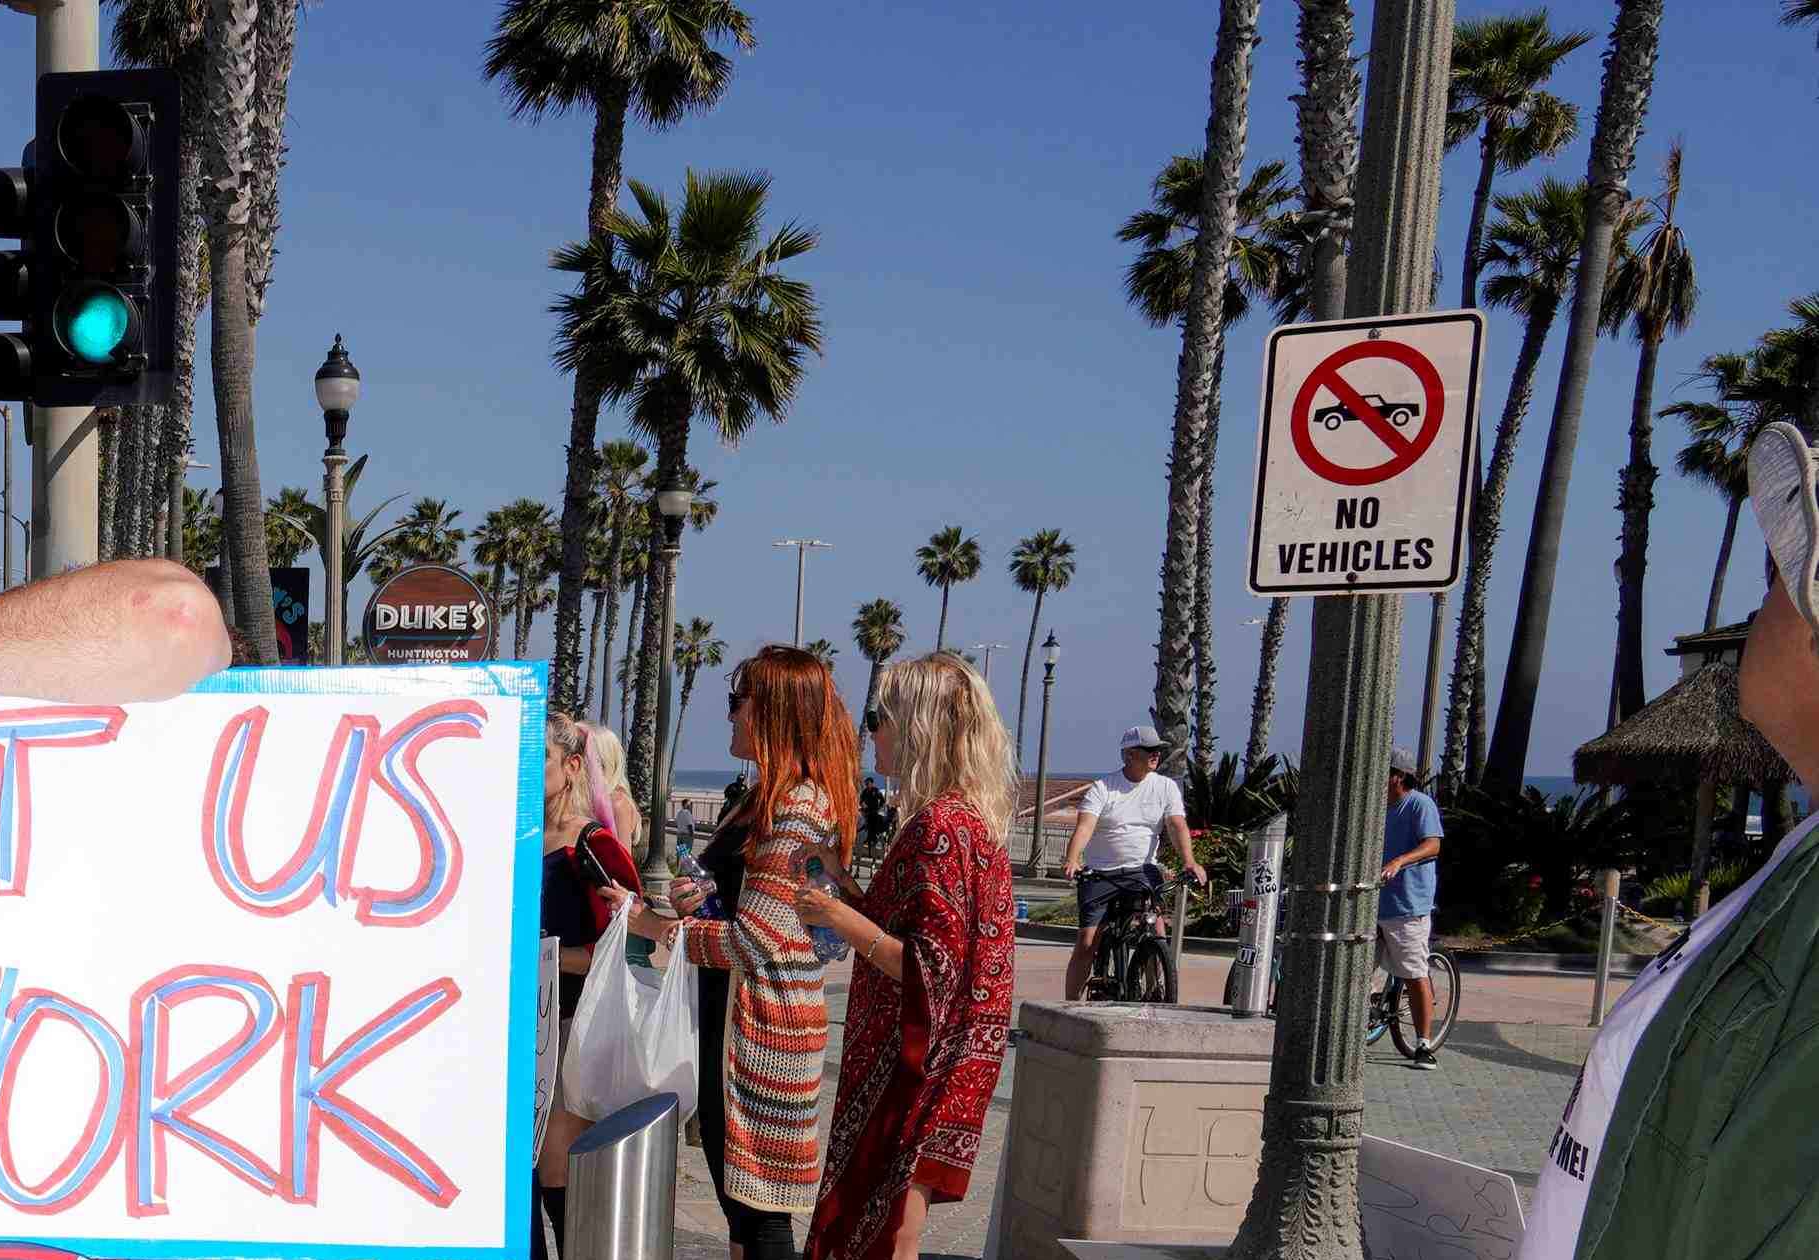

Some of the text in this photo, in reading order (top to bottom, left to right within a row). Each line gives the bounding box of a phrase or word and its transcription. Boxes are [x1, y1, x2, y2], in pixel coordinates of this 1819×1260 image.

[1335, 497, 1380, 530] NO
[1278, 537, 1434, 574] VEHICLES
[375, 600, 487, 631] DUKE'S
[387, 649, 469, 659] HUNTINGTON
[201, 699, 489, 928] US
